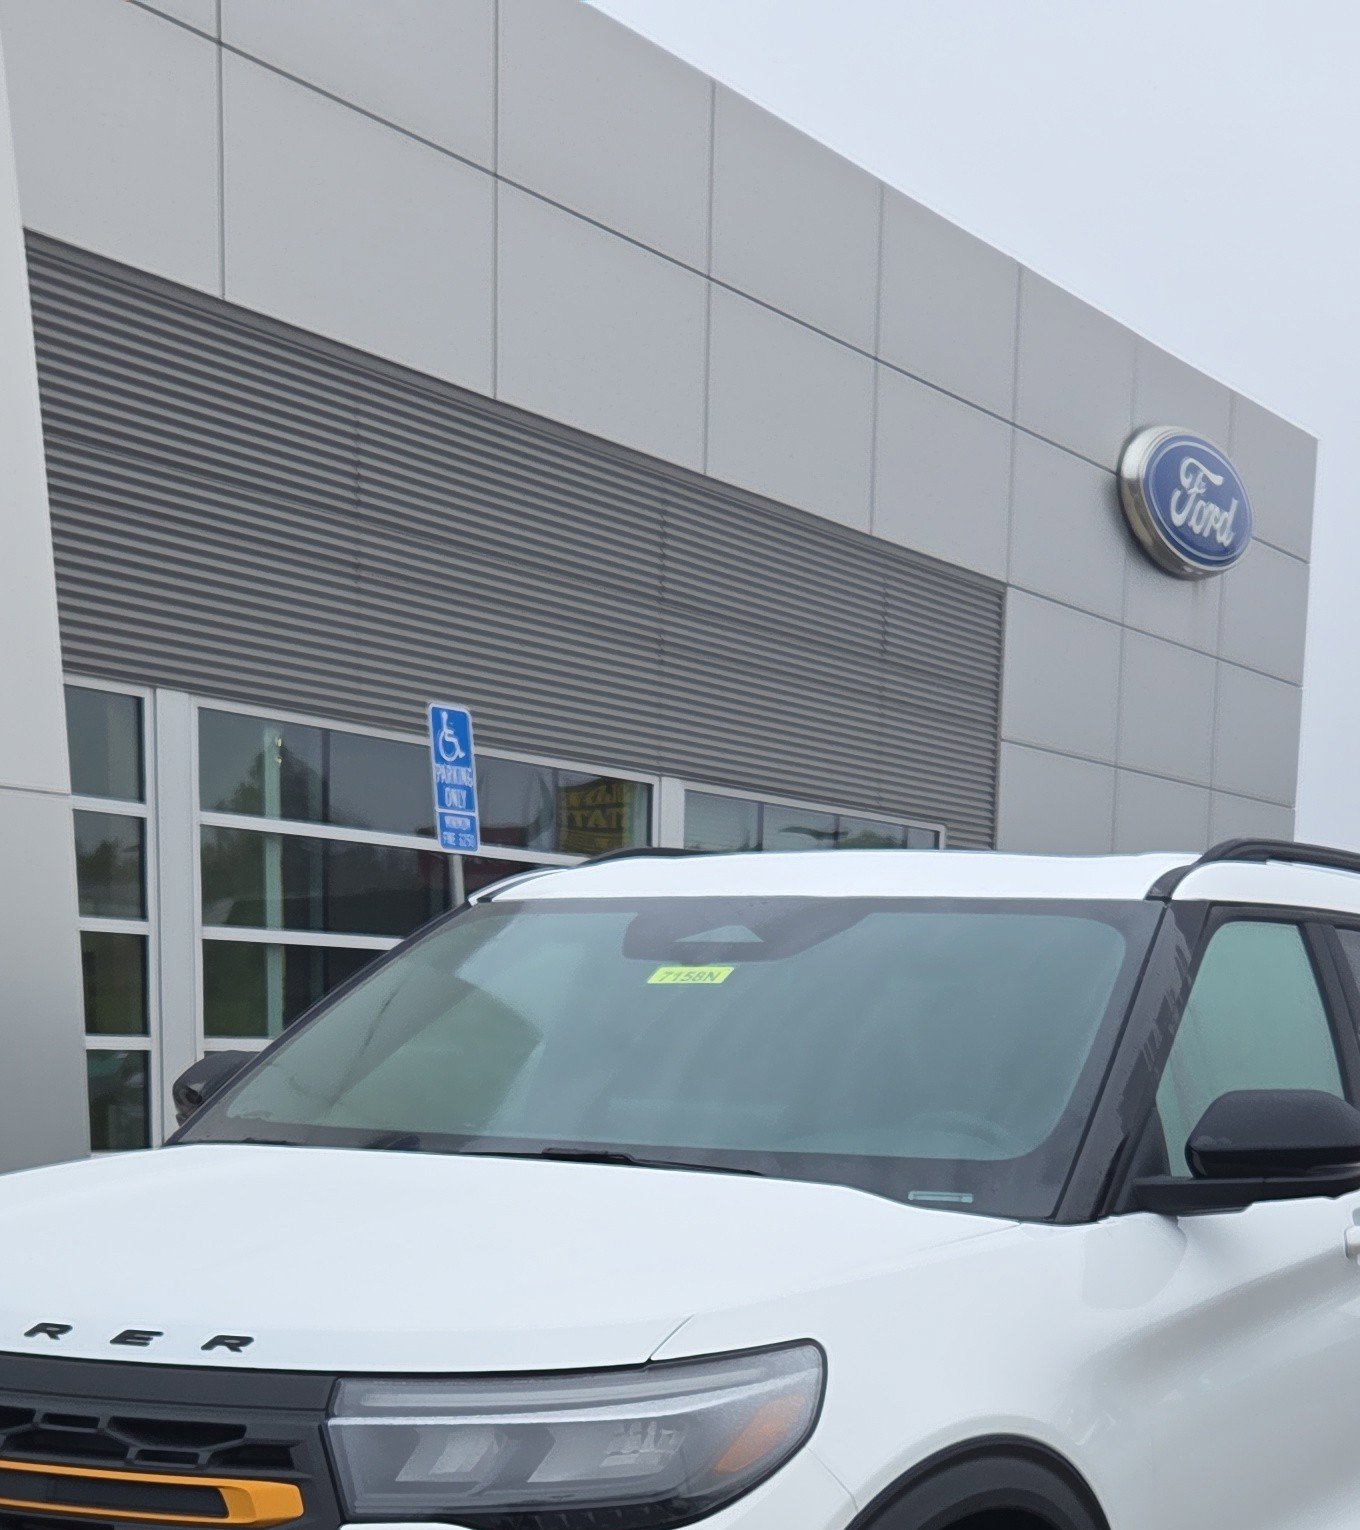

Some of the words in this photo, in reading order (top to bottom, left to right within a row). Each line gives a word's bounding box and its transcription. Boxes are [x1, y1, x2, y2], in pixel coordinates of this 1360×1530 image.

[1169, 456, 1239, 548] Ford
[435, 764, 473, 788] PARKING
[444, 787, 467, 809] ONLY
